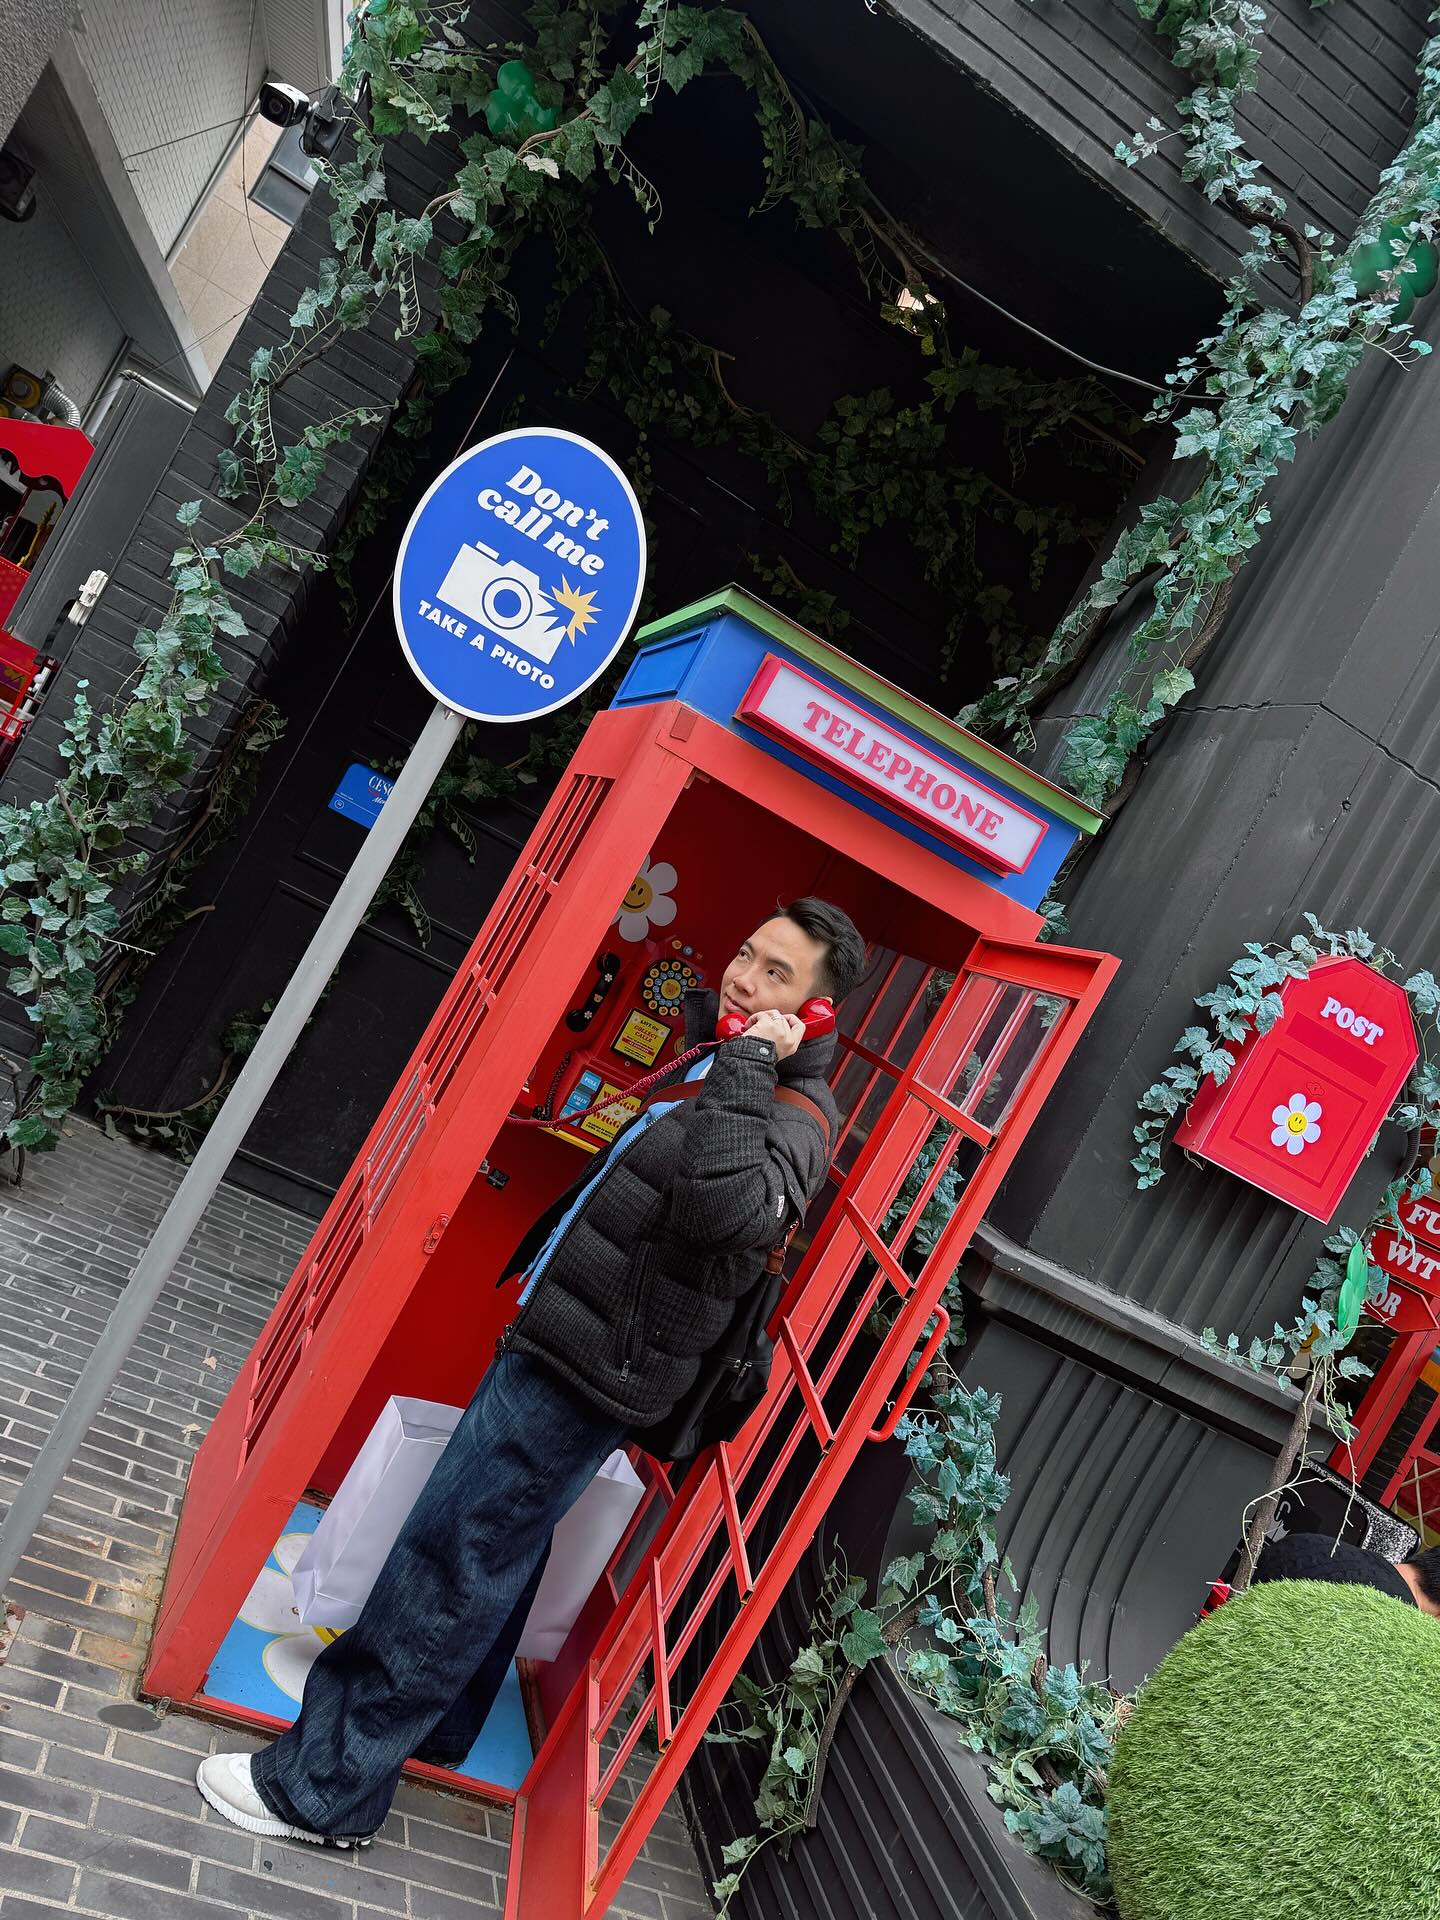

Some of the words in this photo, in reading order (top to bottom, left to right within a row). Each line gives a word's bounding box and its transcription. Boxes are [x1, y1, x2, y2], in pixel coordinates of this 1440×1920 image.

[477, 488, 553, 541] call
[542, 531, 605, 576] me
[505, 465, 609, 541] Don't
[417, 599, 468, 639] TAKE
[469, 633, 485, 651] A
[490, 643, 555, 689] PHOTO
[802, 701, 1004, 841] TELEPHONE
[1320, 996, 1384, 1045] POST
